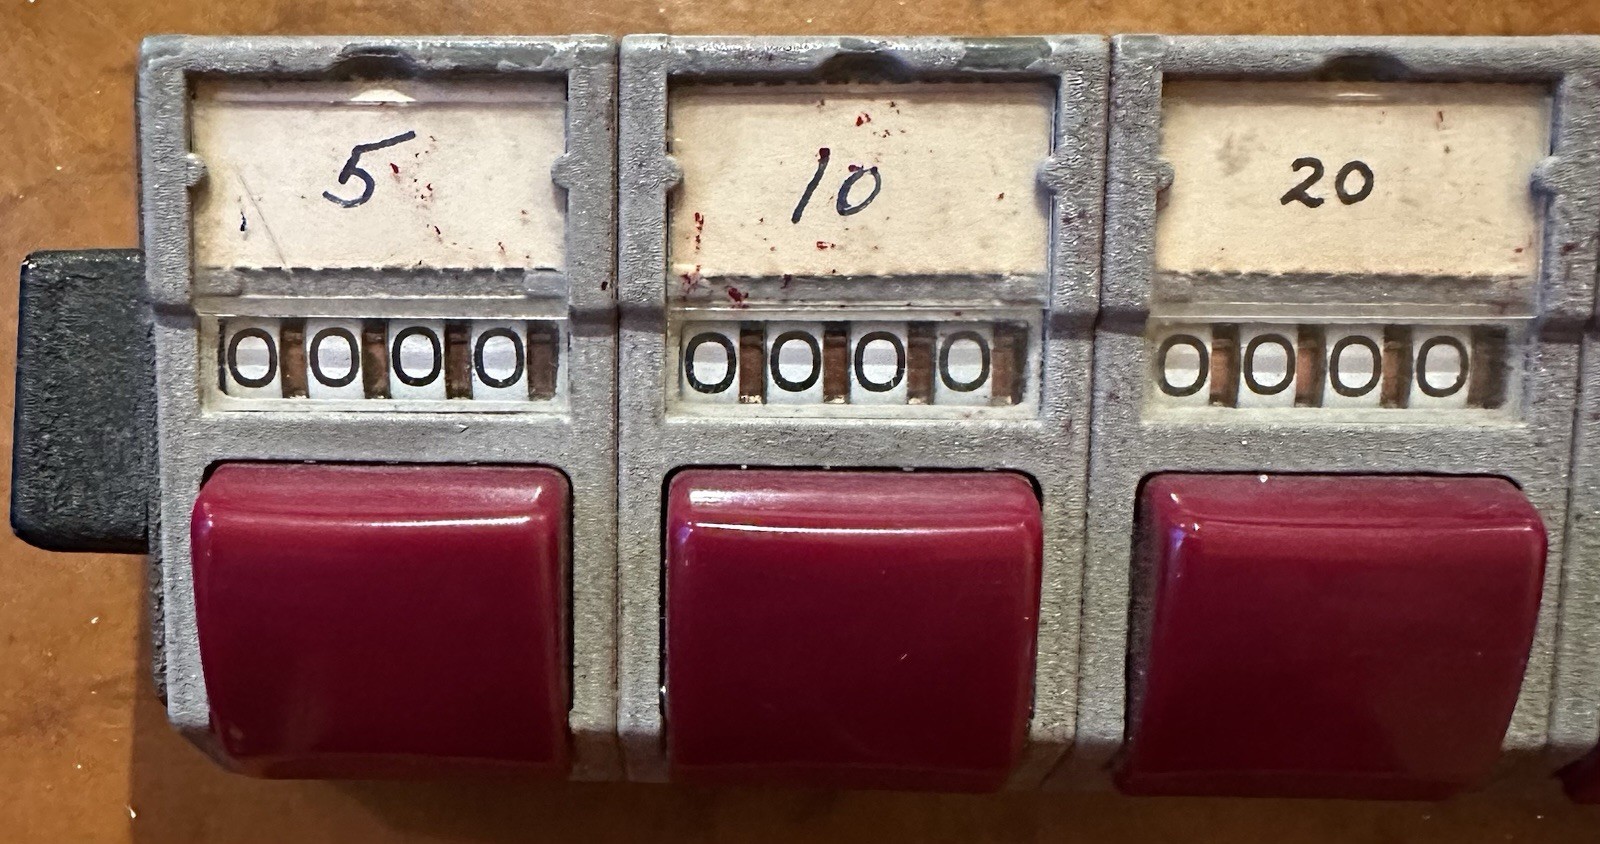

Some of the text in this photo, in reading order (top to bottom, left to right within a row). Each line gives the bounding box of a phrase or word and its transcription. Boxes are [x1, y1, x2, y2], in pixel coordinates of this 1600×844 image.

[322, 130, 416, 208] 5
[791, 147, 882, 223] 10
[1280, 157, 1374, 208] 20
